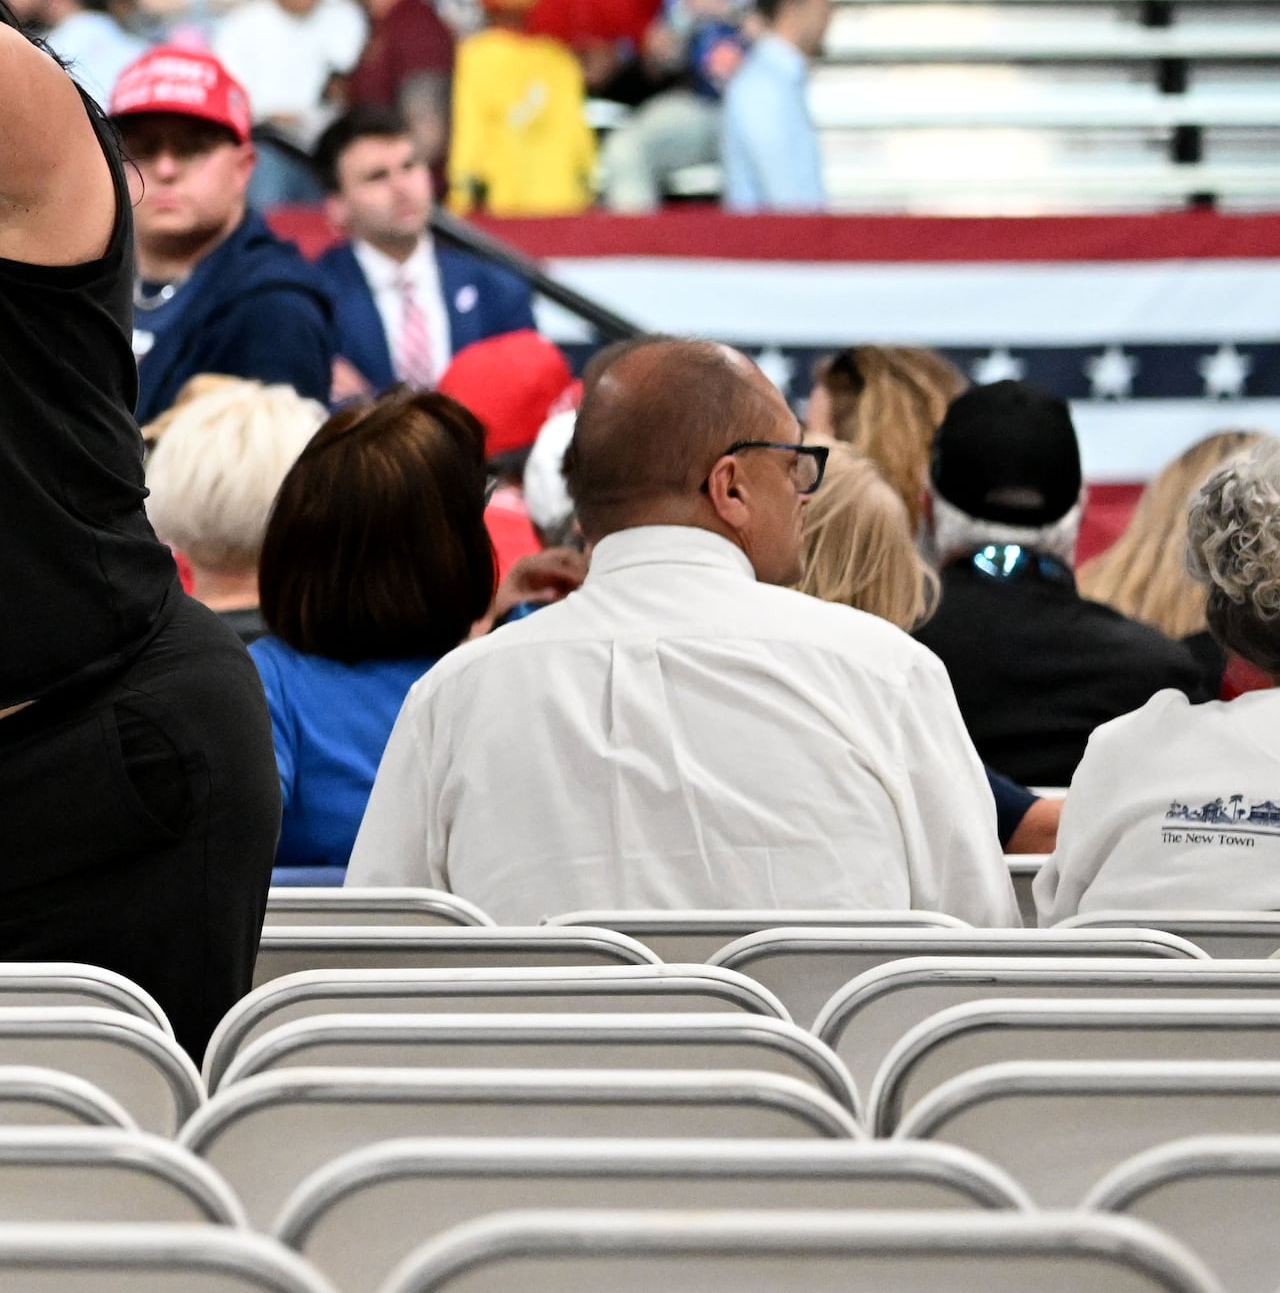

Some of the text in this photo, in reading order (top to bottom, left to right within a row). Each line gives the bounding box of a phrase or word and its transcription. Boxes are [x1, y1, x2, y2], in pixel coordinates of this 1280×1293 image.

[1162, 832, 1255, 847] The New Town
